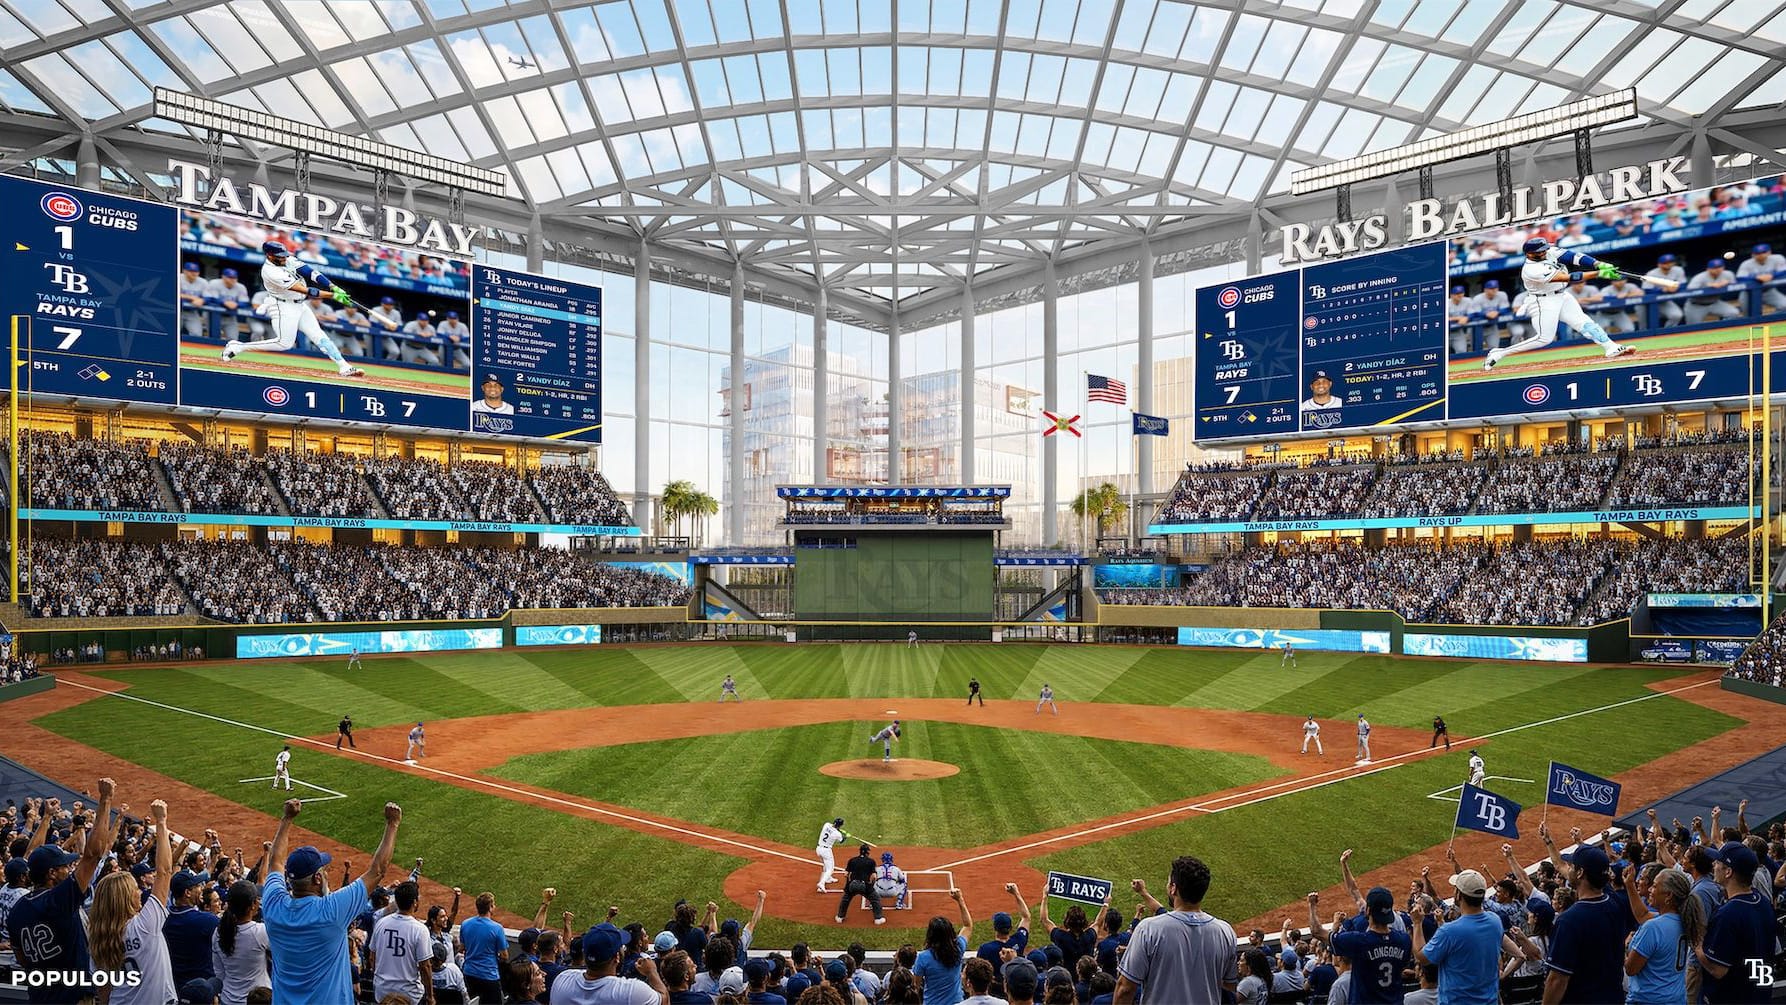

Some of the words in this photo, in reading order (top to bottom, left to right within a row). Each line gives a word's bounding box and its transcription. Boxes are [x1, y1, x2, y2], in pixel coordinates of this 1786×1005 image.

[88, 205, 137, 219] CHICAGO
[168, 158, 372, 237] TAMPA
[382, 204, 480, 257] BAY
[1280, 214, 1388, 265] RAYS
[1404, 155, 1688, 242] BALLPARK
[88, 214, 138, 231] CUBS
[54, 226, 73, 250] 1
[59, 252, 74, 260] VS
[44, 262, 89, 294] TB
[483, 269, 501, 284] TB
[506, 278, 539, 289] TODAY'S
[540, 285, 567, 293] LINEUP
[1244, 284, 1274, 294] CHICAGO
[1309, 285, 1326, 298] TB
[1332, 284, 1356, 293] SCORE
[1370, 277, 1397, 286] INNING
[37, 293, 77, 305] TAMPA
[80, 299, 103, 308] BAY
[499, 295, 532, 305] JONATHAN
[1244, 291, 1274, 304] CUBS
[36, 302, 95, 319] RAYS
[1225, 311, 1235, 328] 1
[53, 326, 82, 350] 7
[497, 335, 529, 344] CHANDLER
[1219, 340, 1245, 360] TB
[34, 362, 58, 371] 5TH
[1216, 363, 1237, 371] TAMPA
[1345, 363, 1353, 371] 2
[1357, 361, 1384, 369] YANDY
[1386, 358, 1406, 366] DÍAZ
[137, 370, 153, 378] 2-1
[516, 373, 524, 381] 2
[527, 376, 552, 384] YANDY
[553, 379, 570, 387] DÍAZ
[1216, 368, 1248, 380] RAYS
[1345, 376, 1374, 384] TODAY:
[1686, 370, 1706, 390] 7
[127, 378, 134, 386] 2
[137, 380, 166, 389] OUTS
[1631, 374, 1662, 396] TB
[1224, 386, 1240, 404] 7
[1567, 383, 1578, 400] 1
[305, 392, 316, 408] 1
[361, 396, 385, 417] TB
[402, 401, 416, 417] 7
[98, 512, 135, 521] TAMPA
[138, 513, 158, 522] BAY
[161, 514, 187, 522] RAYS
[293, 517, 321, 526] TAMPA
[322, 518, 340, 527] BAY
[342, 519, 366, 528] RAYS
[1419, 518, 1445, 526] RAYS
[1448, 517, 1462, 525] UP
[1593, 512, 1633, 522] TAMPA
[1638, 510, 1663, 520] BAY
[1665, 510, 1698, 520] RAYS
[450, 522, 474, 530] TAMPA
[572, 526, 597, 534] TAMPA
[598, 527, 612, 535] BAY
[613, 527, 629, 536] RAYS
[1295, 521, 1319, 529] RAYS
[1552, 769, 1614, 806] RAYS
[1474, 792, 1506, 831] TB
[823, 833, 829, 842] 2
[1051, 877, 1064, 893] TB
[1071, 882, 1105, 899] RAYS
[21, 923, 62, 963] 42
[384, 929, 406, 956] TB
[1378, 962, 1392, 987] 3
